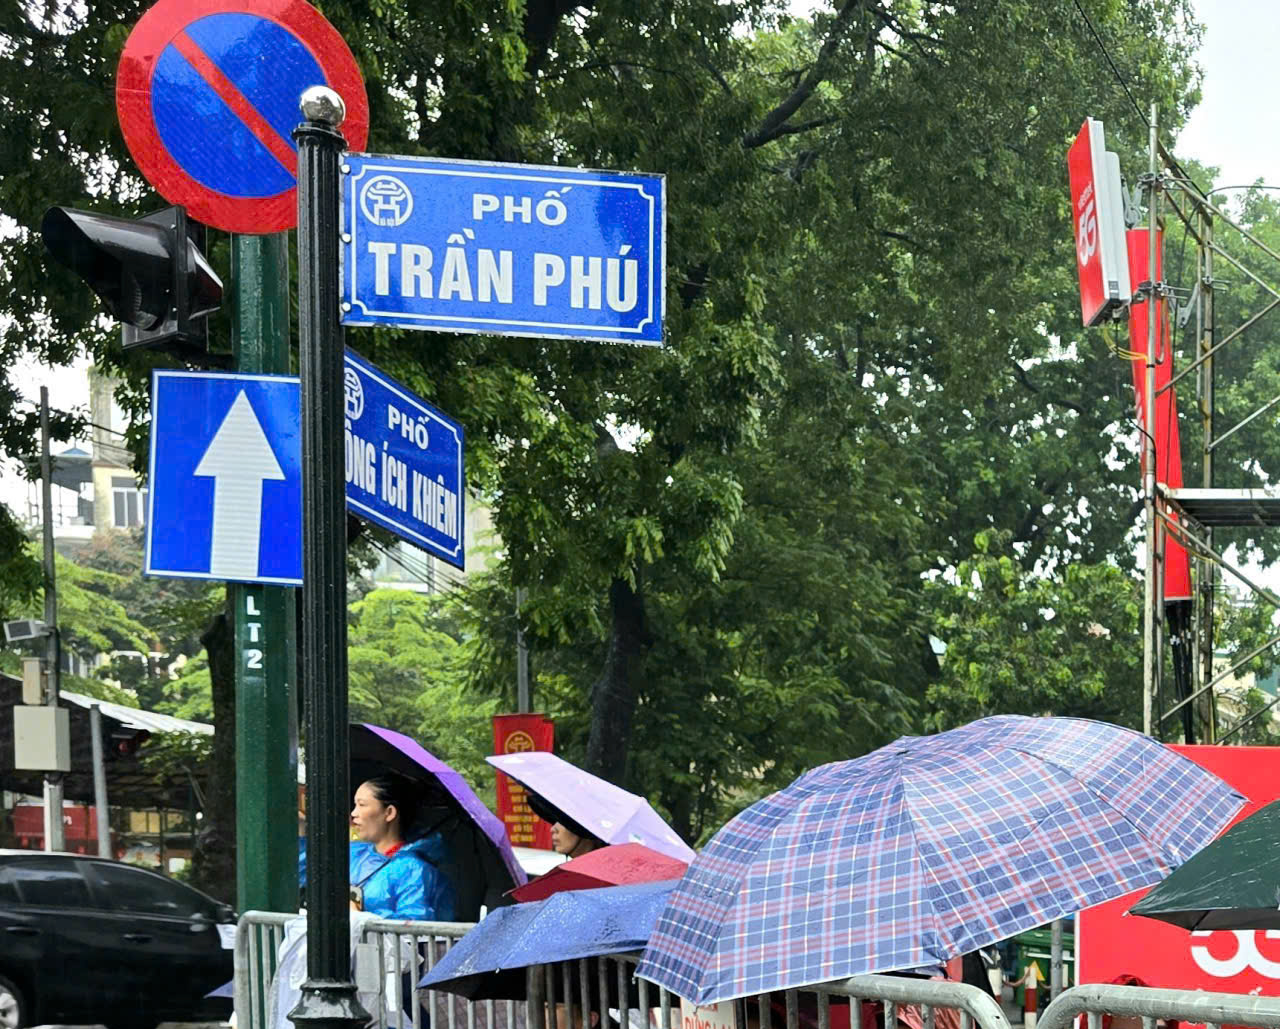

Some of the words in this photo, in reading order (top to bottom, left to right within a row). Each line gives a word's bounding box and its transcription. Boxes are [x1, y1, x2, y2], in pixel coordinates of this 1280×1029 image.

[472, 186, 573, 226] PHỐ
[367, 228, 513, 304] TRẦN
[533, 244, 638, 313] PHÚ
[388, 403, 430, 450] PHỐ
[381, 440, 408, 512] ÍCH
[412, 473, 457, 540] KHIÊM
